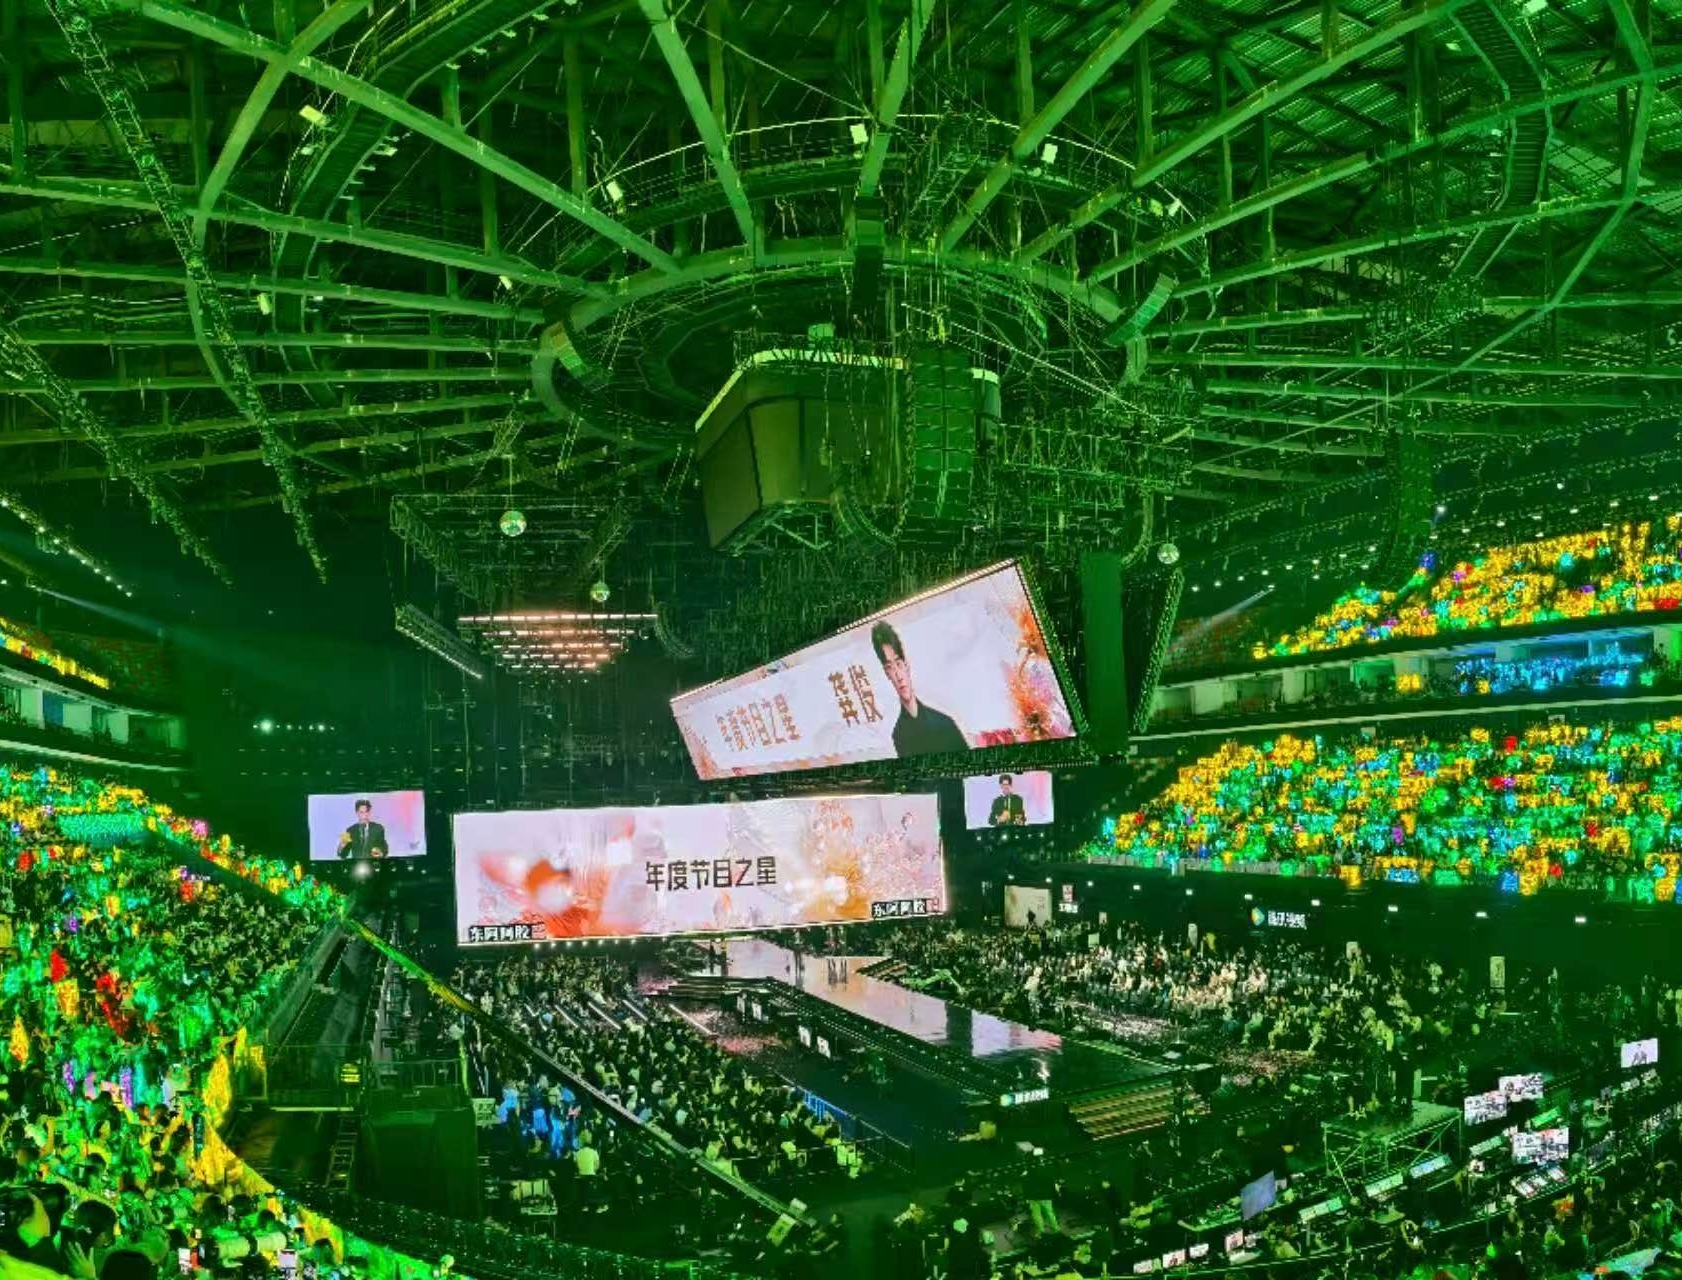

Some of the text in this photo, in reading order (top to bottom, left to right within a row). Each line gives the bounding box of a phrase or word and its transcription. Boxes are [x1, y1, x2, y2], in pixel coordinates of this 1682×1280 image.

[646, 856, 777, 891] 年度节目之星
[470, 924, 531, 942] 东阿阿胶
